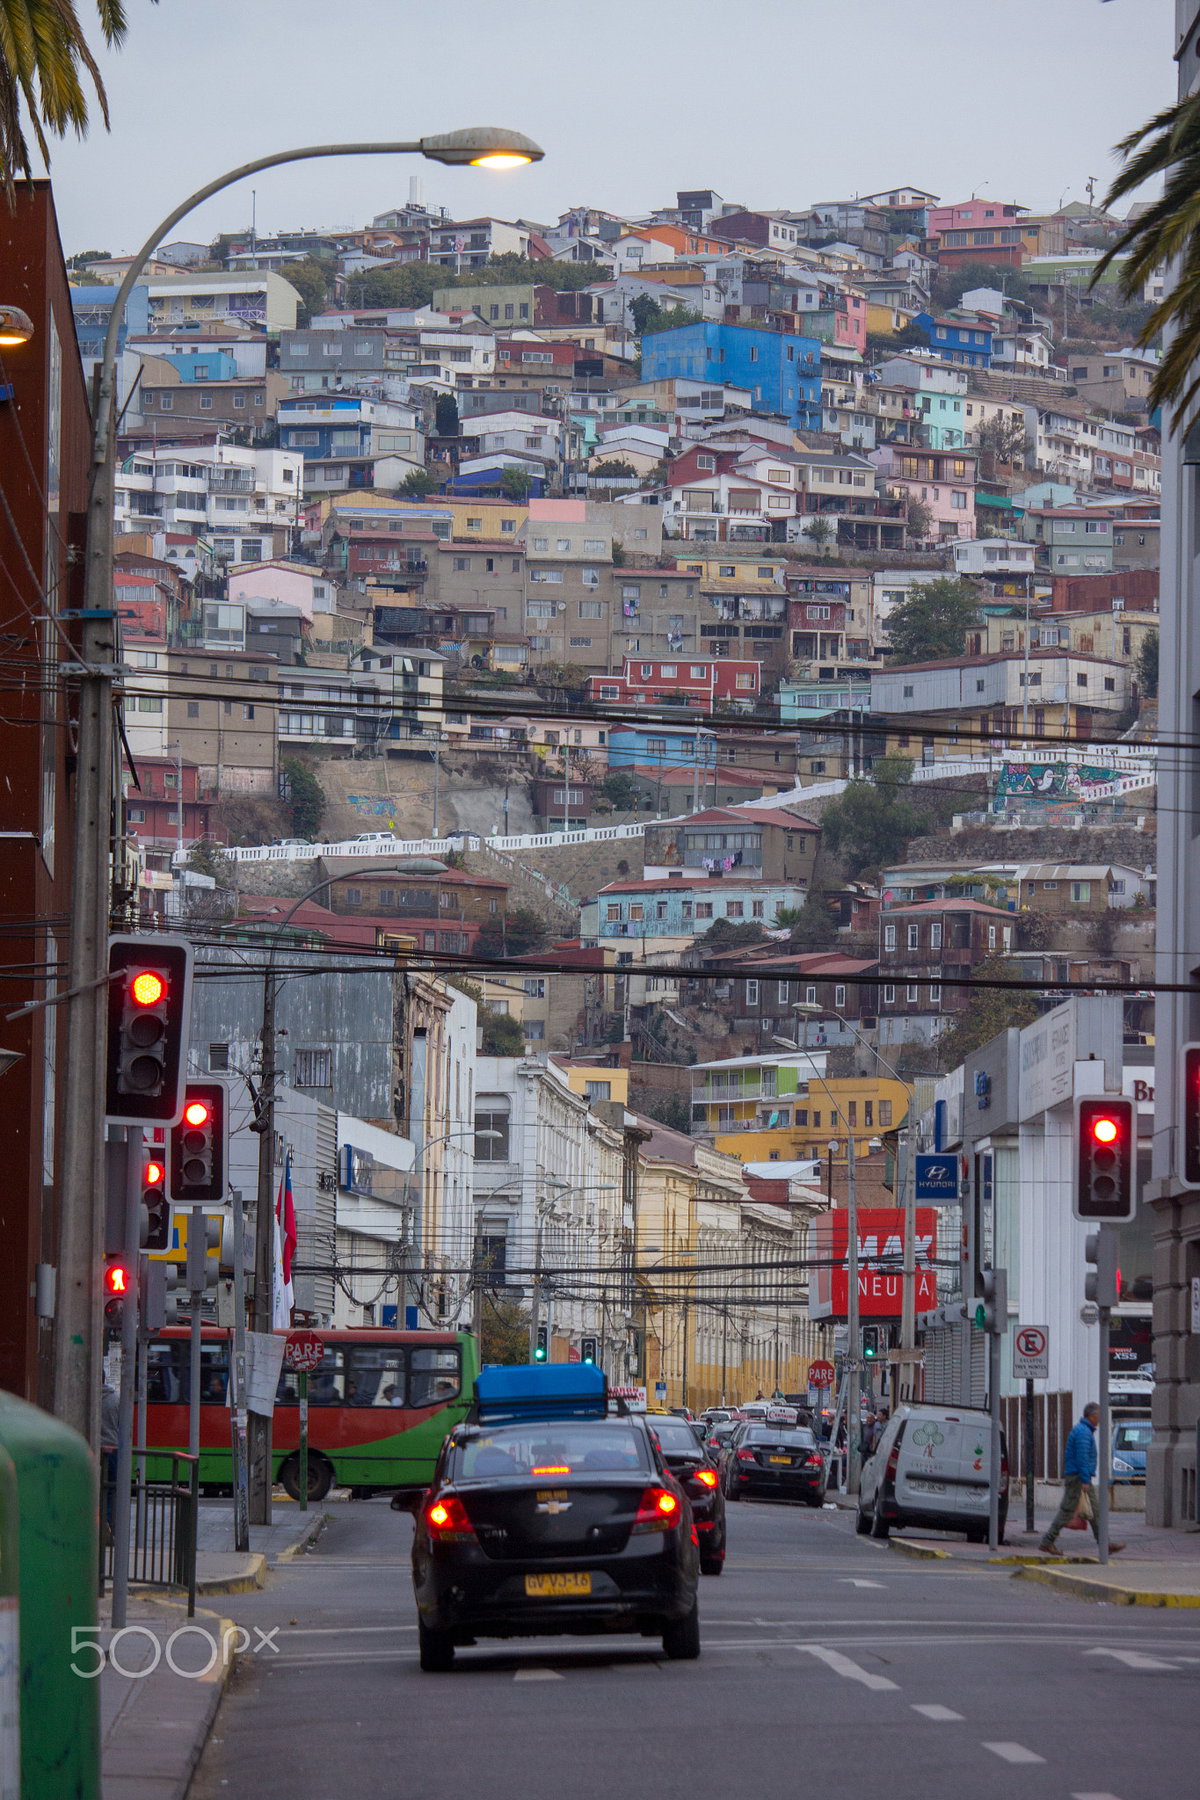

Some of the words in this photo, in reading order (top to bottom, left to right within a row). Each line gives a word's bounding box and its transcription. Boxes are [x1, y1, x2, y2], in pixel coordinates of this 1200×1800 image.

[919, 1180, 956, 1188] HYUNDAI
[857, 1273, 930, 1296] NEUÁ
[285, 1343, 322, 1359] PARE
[808, 1368, 834, 1380] PARE
